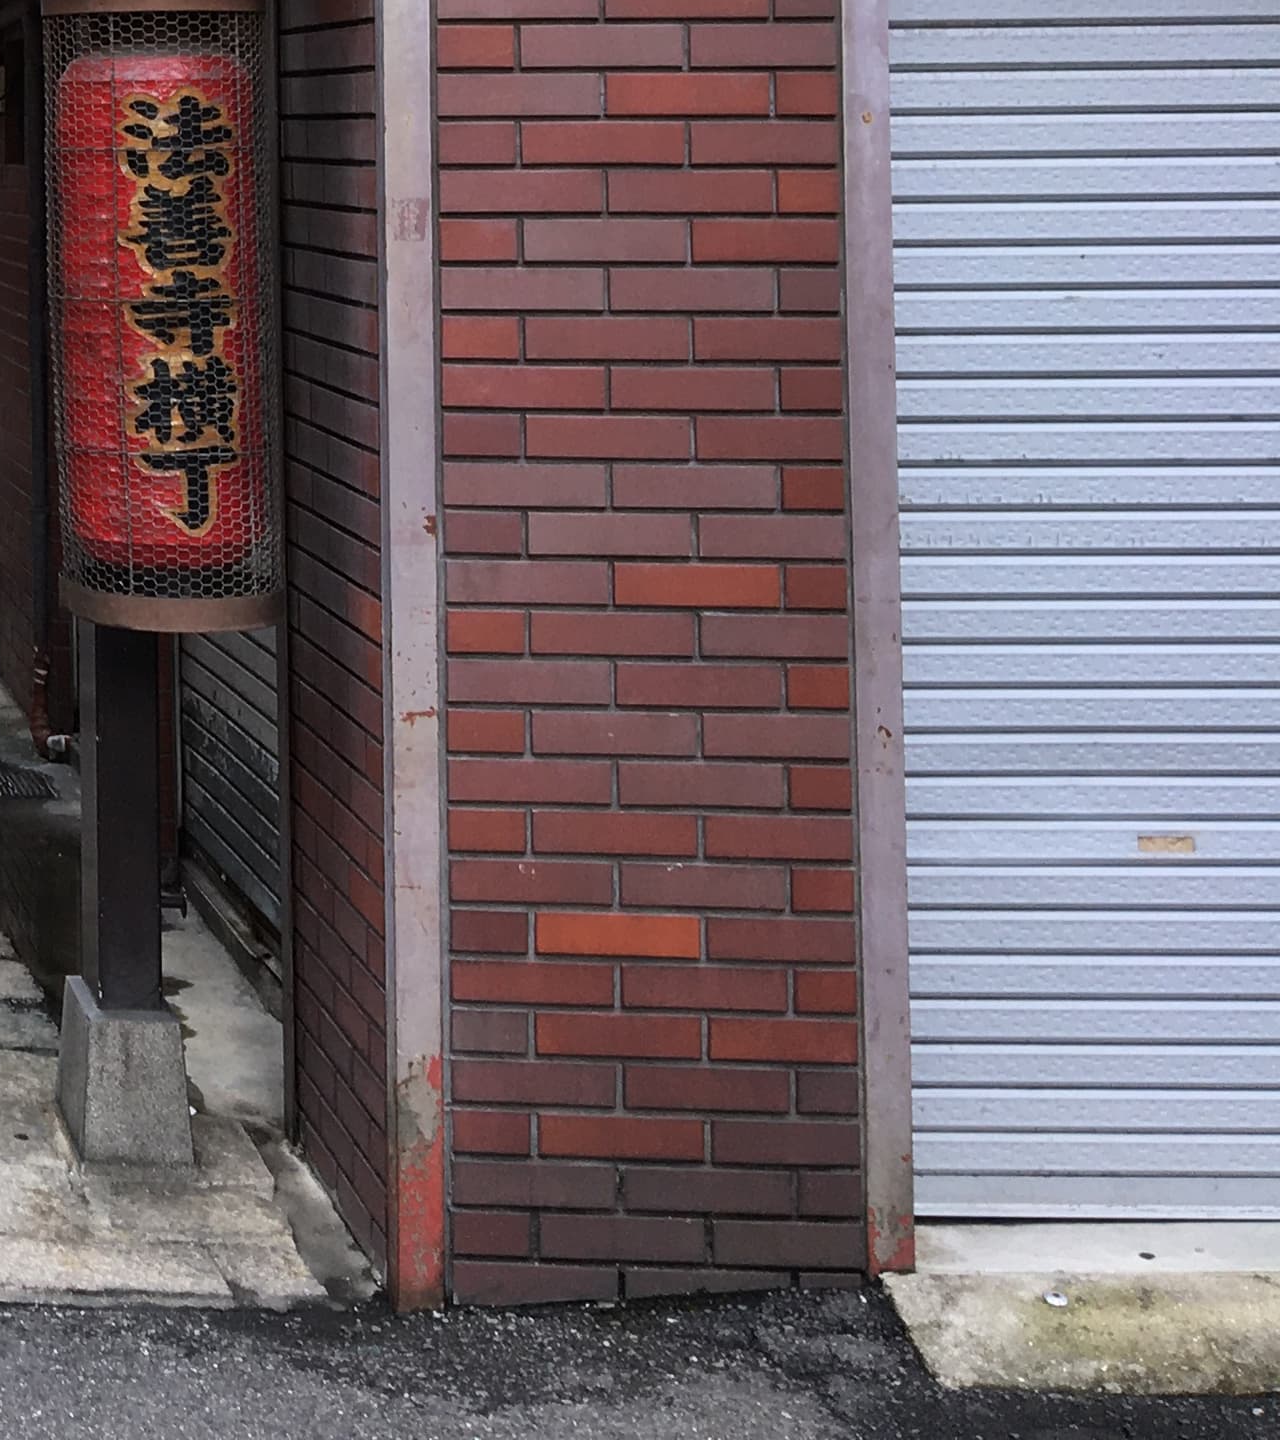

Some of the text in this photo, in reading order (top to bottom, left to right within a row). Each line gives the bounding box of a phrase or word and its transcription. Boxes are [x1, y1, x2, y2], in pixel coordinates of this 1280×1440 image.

[124, 94, 235, 530] 法善寺横丁
